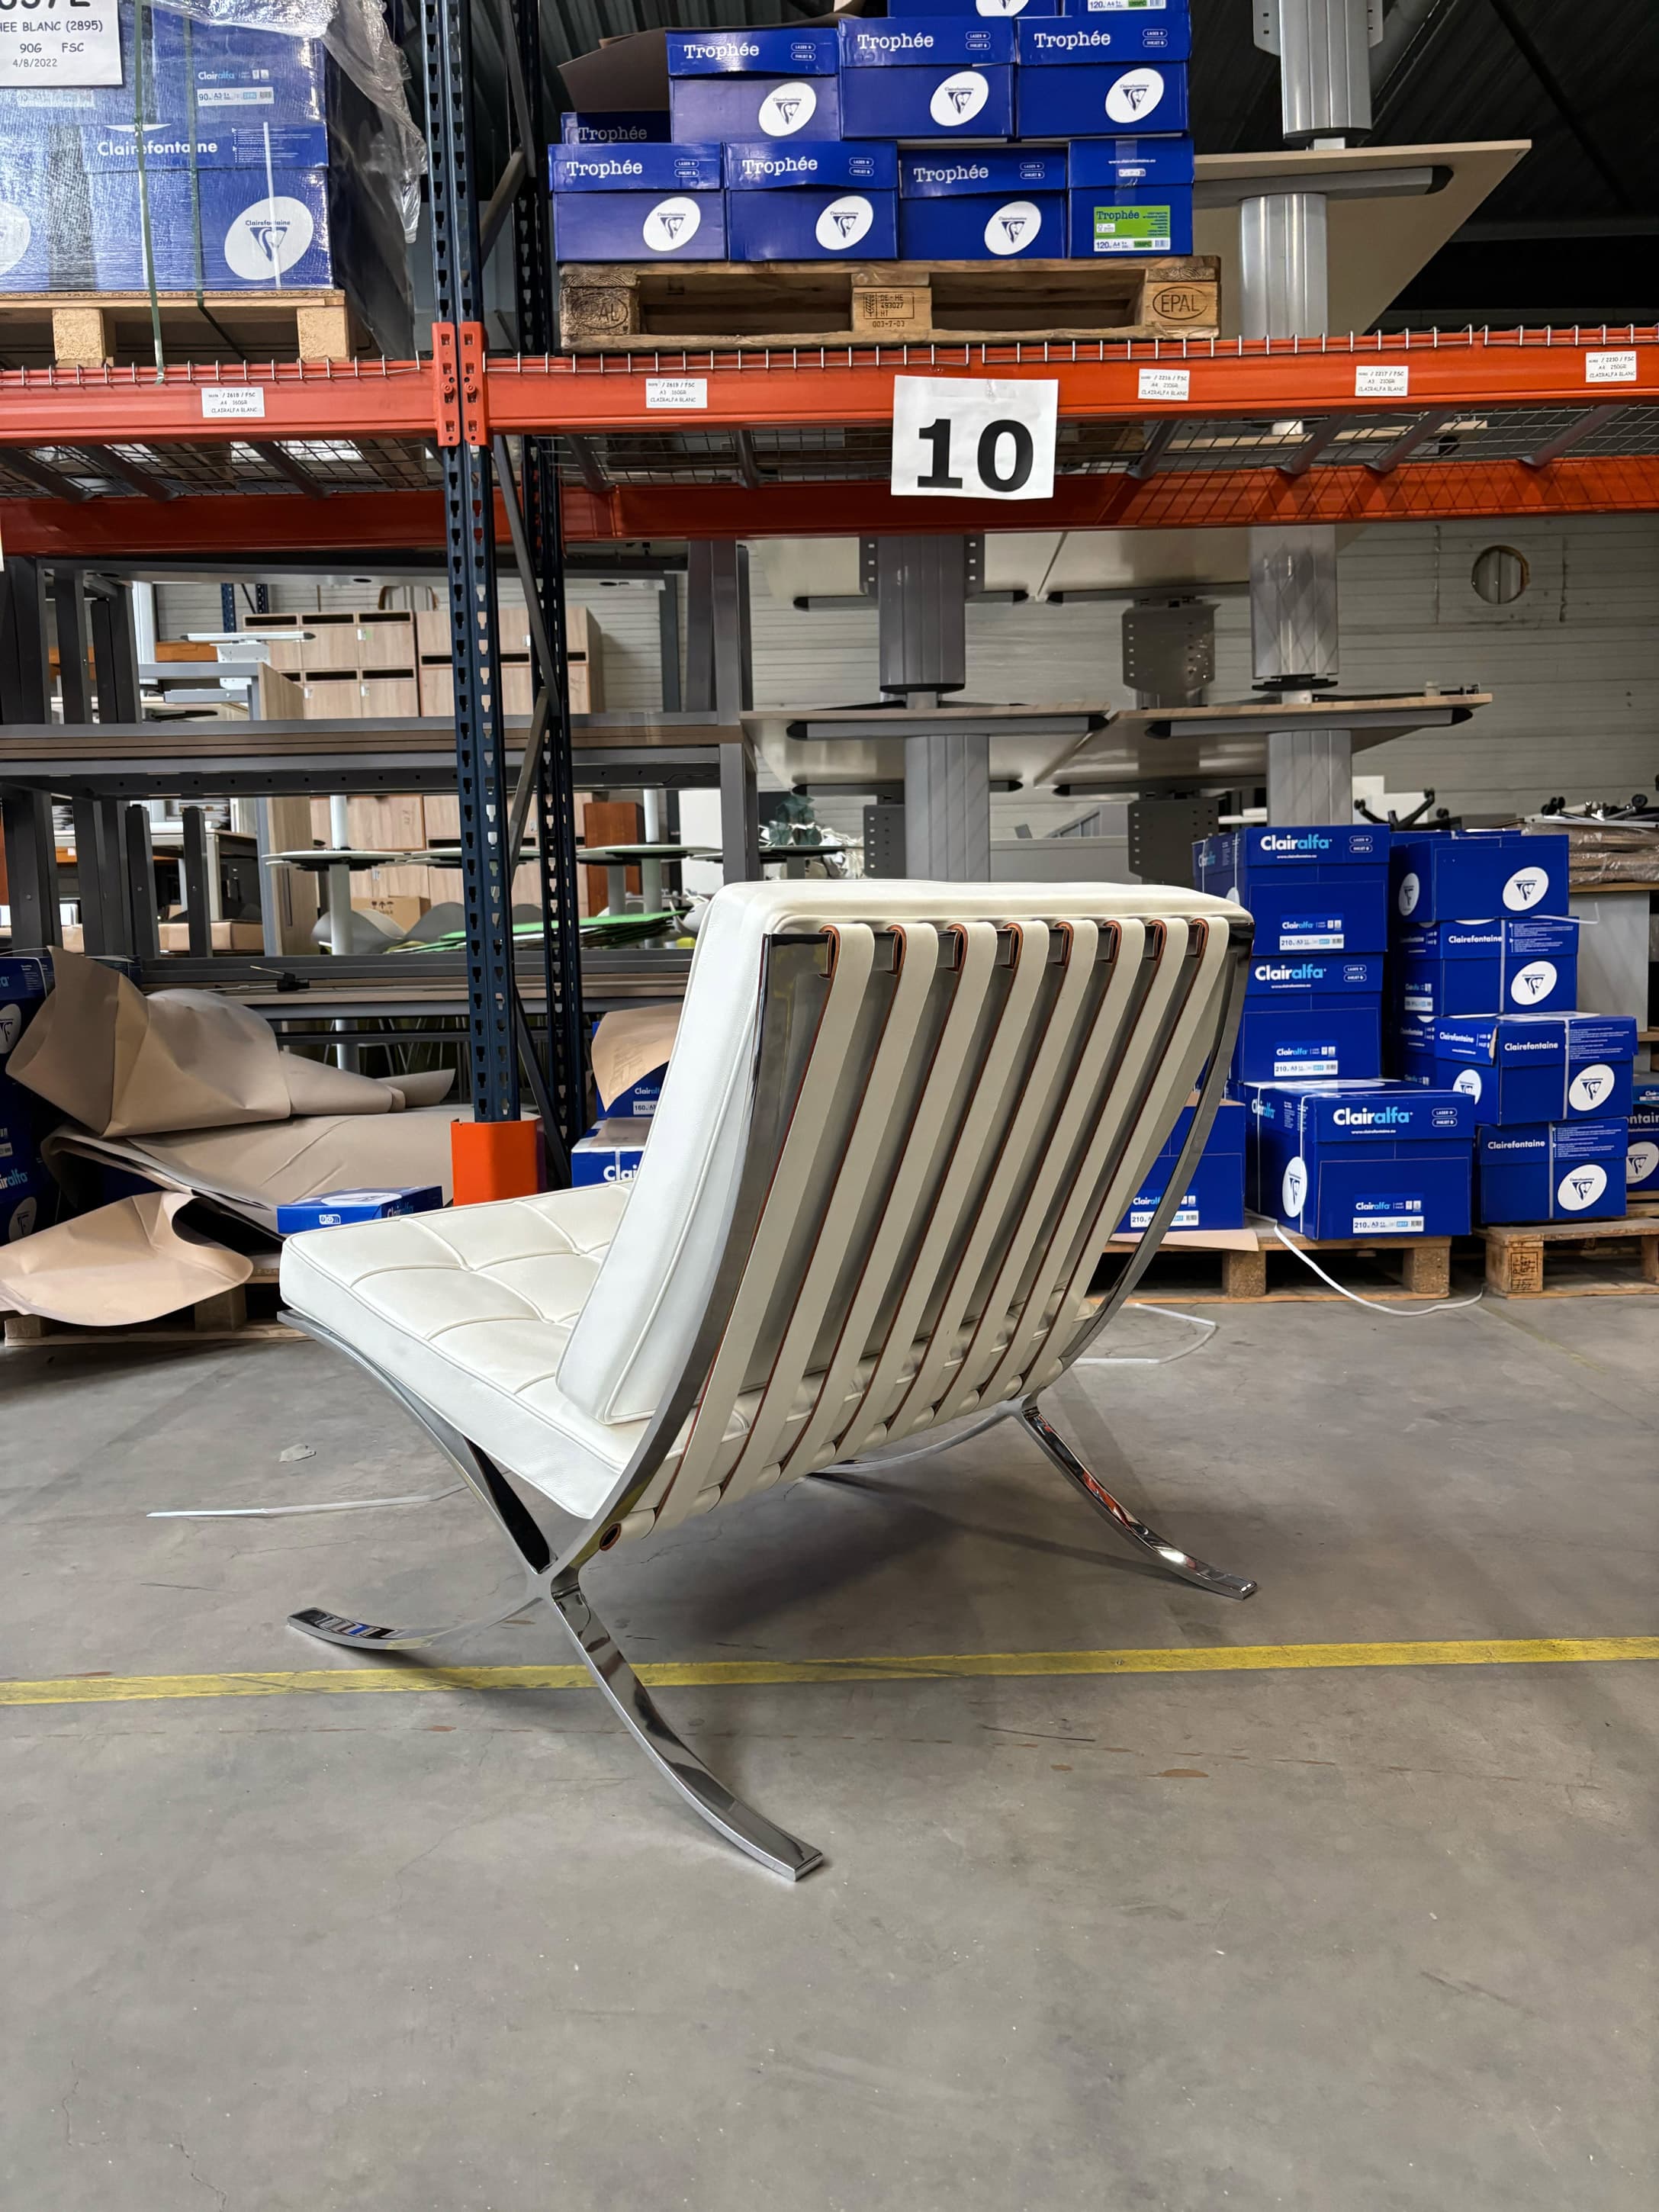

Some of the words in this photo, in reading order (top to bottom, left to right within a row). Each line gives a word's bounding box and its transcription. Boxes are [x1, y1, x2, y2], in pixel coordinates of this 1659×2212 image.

[0, 22, 17, 32] EE
[23, 21, 61, 31] BLANC
[66, 20, 103, 33] (2895)
[20, 43, 42, 53] 90G
[62, 43, 84, 53] FSC
[857, 33, 934, 51] Trophée
[1034, 31, 1111, 50] Trophée
[684, 43, 759, 59] Trophée
[13, 59, 58, 67] 4/8/2022
[198, 71, 236, 80] Clairalfa
[578, 126, 647, 143] Trophée
[97, 140, 217, 156] Clairfontane
[567, 159, 642, 178] Trophée
[742, 156, 818, 176] Trophée
[914, 165, 989, 183] Trophée
[1096, 210, 1140, 221] Trophée
[1161, 294, 1200, 313] EPAL
[918, 419, 1034, 492] 10
[1260, 834, 1330, 850] Clairalfa
[1281, 921, 1313, 929] Clairalfa
[1448, 934, 1503, 944] Clairefontaine
[1255, 963, 1323, 981] Clairalfa
[1439, 1031, 1474, 1043] Clairefontaine
[1276, 1047, 1308, 1056] Clairalfa
[1504, 1041, 1559, 1051] Clairefontaine
[1333, 1106, 1410, 1125] Clairalfa
[1487, 1139, 1545, 1149] Clairefontaine
[1355, 1201, 1390, 1210] Clairalfa
